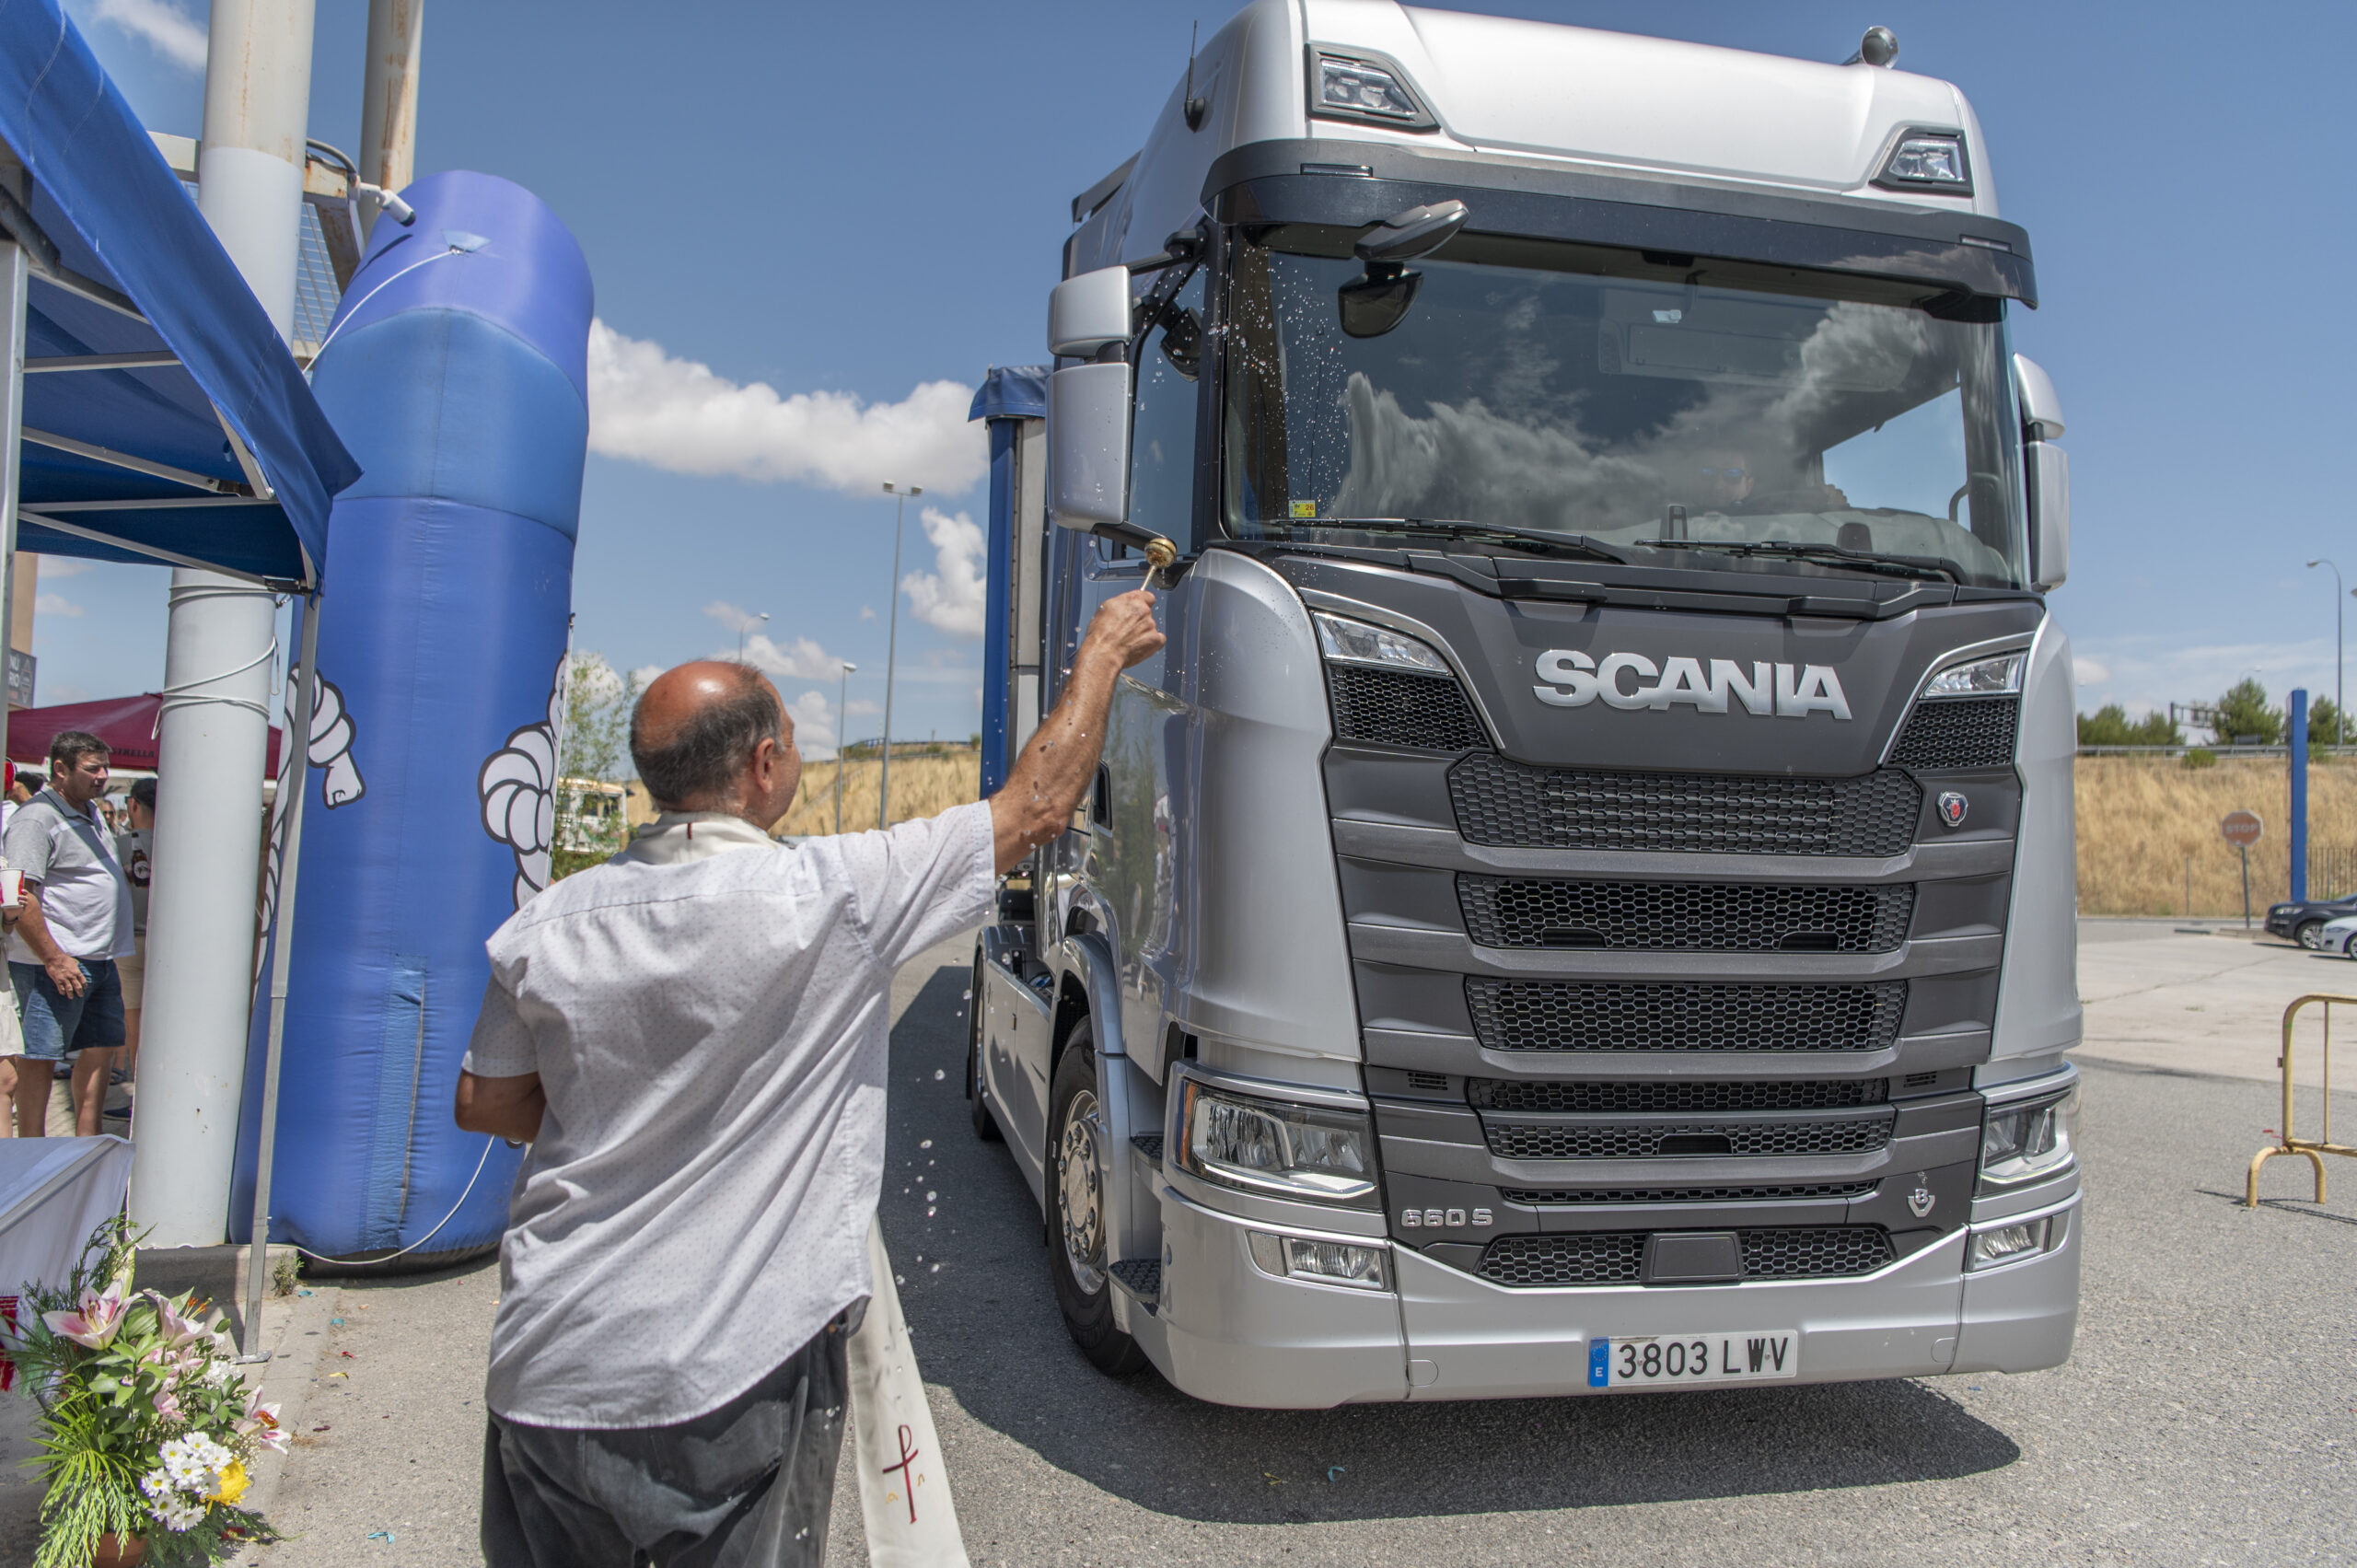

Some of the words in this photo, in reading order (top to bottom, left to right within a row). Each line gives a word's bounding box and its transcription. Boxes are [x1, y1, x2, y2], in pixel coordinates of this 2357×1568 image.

[1533, 649, 1852, 720] SCANIA
[110, 748, 155, 758] STRELLA
[2225, 823, 2258, 833] STOP
[1401, 1209, 1466, 1226] 660
[1472, 1208, 1492, 1225] S
[1596, 1367, 1603, 1376] E
[1618, 1341, 1708, 1378] 3803
[1723, 1337, 1788, 1374] LWV
